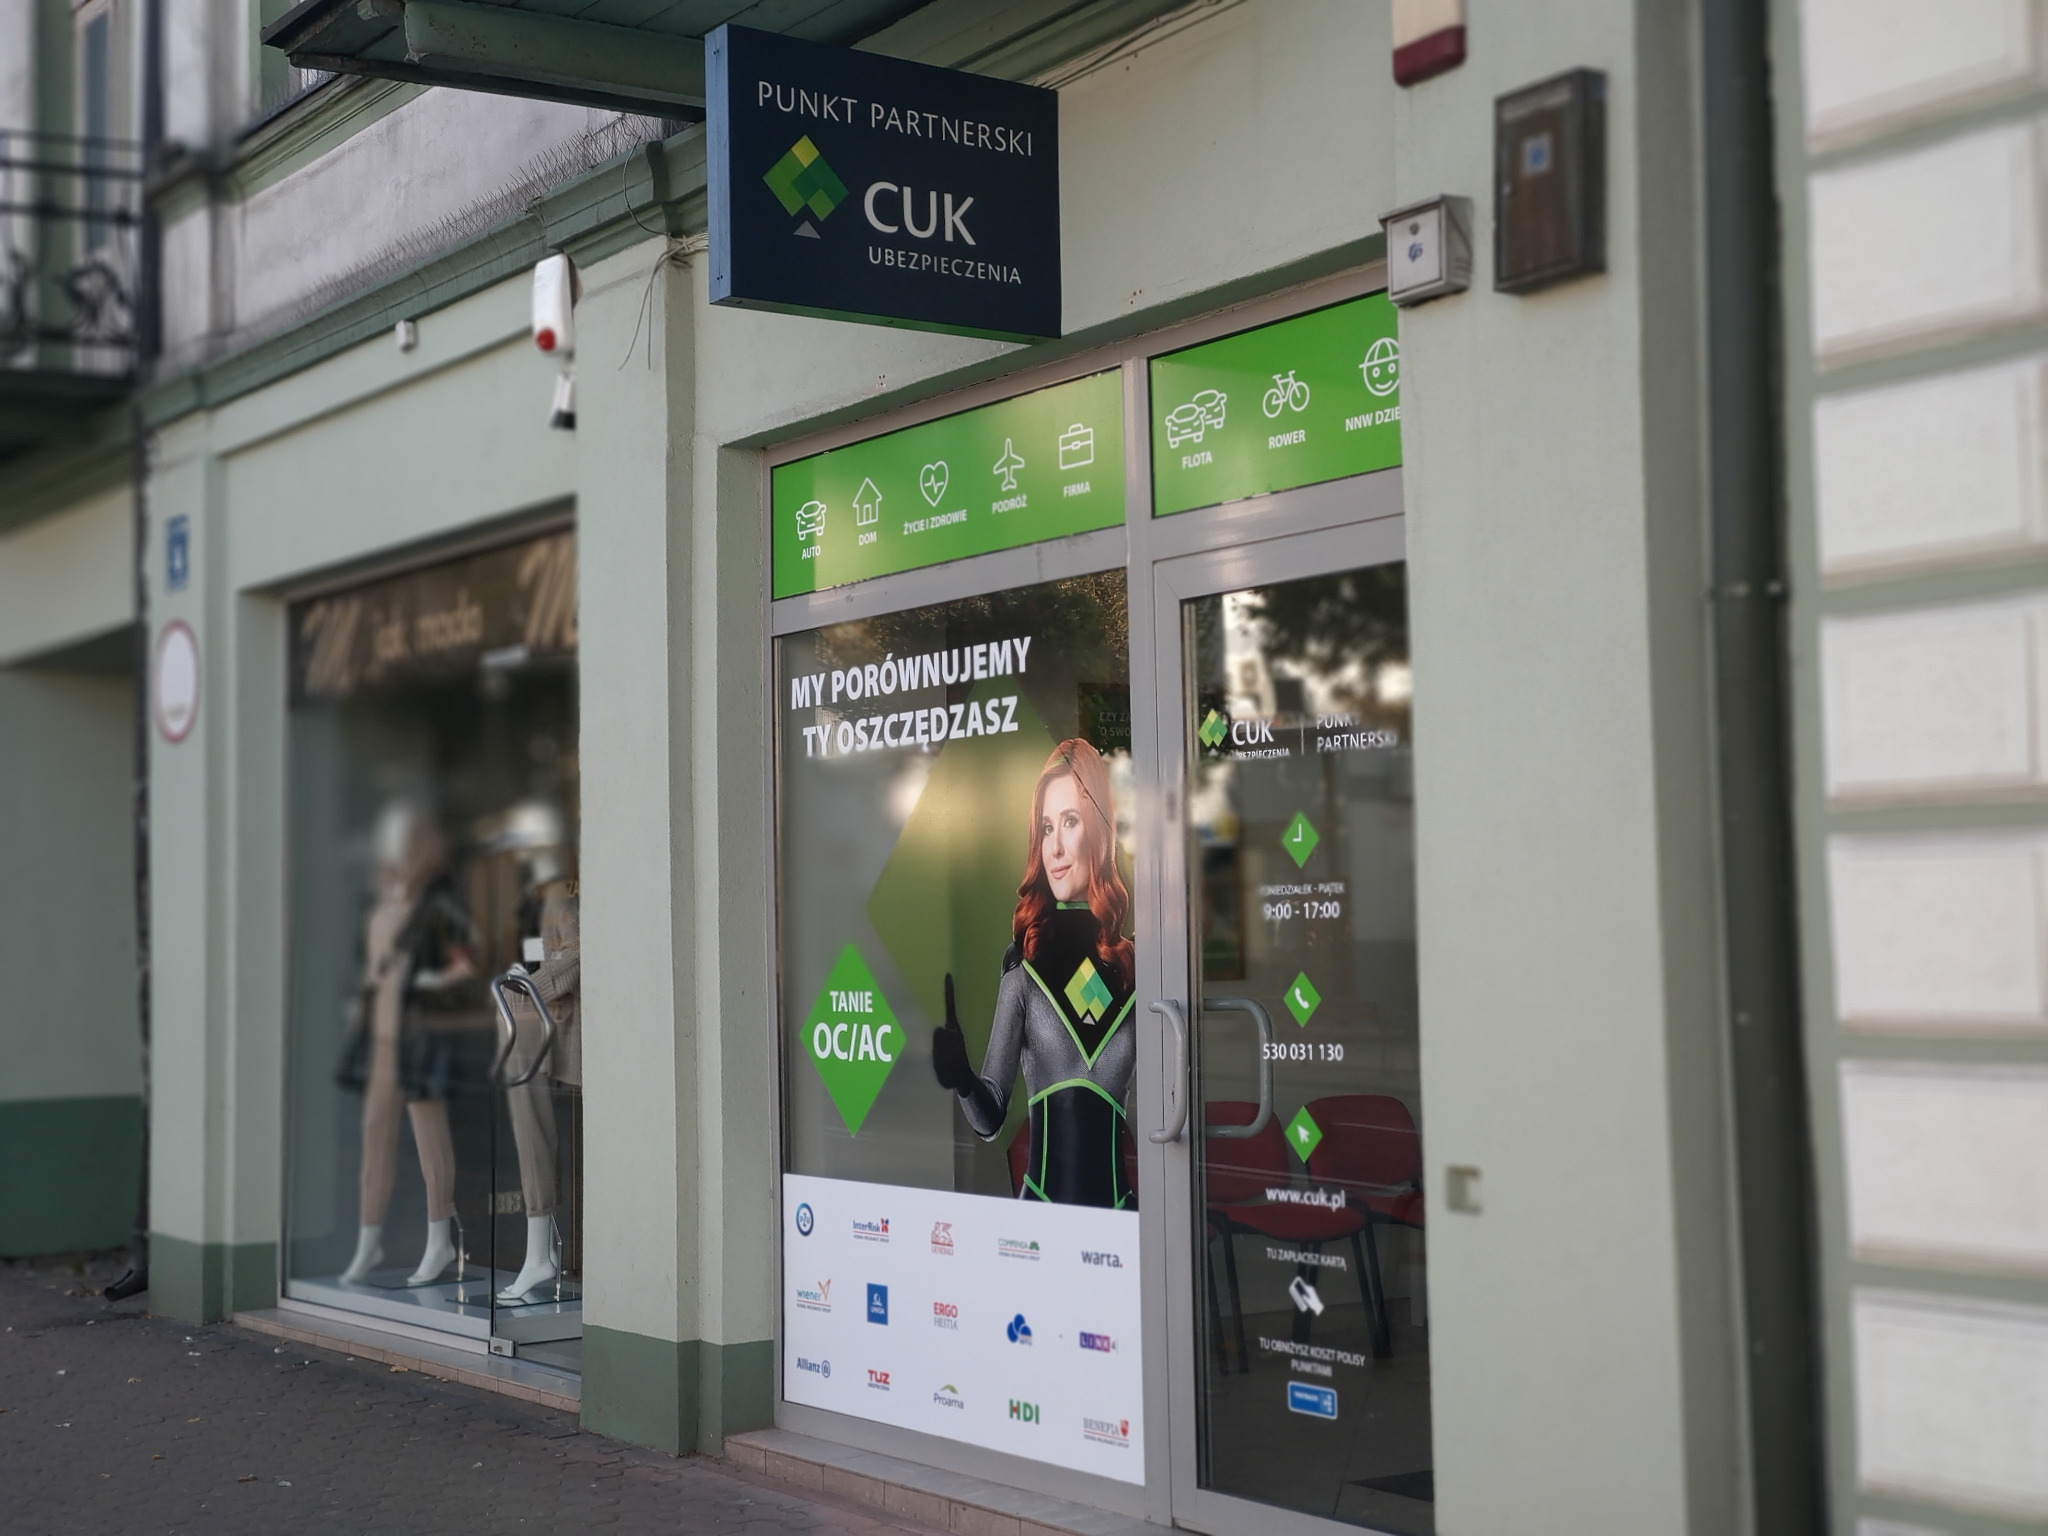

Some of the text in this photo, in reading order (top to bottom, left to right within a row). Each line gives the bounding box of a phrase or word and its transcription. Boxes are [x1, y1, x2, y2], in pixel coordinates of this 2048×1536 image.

[758, 81, 1033, 156] PUNKT PARTNERSKI
[864, 182, 976, 245] CUK
[868, 246, 1022, 285] UBEZPIECZENIA
[1345, 412, 1373, 431] NNW
[1268, 430, 1306, 449] ROWER
[1181, 451, 1213, 469] FLOTA
[1063, 481, 1091, 497] FIRMA
[992, 495, 1028, 514] PODRÓŻ
[903, 518, 925, 535] ŻYCIE
[930, 509, 967, 530] ZDROWIE
[858, 531, 877, 546] DOM
[801, 545, 821, 559] AUTO
[791, 636, 1031, 710] MY PORÓWNUJEMY
[803, 696, 1019, 758] TY OSZCZĘDZASZ
[1232, 719, 1274, 745] CUK
[1264, 903, 1292, 920] 9:00
[1303, 901, 1340, 919] 17:00
[830, 990, 873, 1013] TANIE
[813, 1022, 892, 1062] OC/AC
[1263, 1043, 1344, 1061] 530 031 130
[1266, 1188, 1346, 1212] www.cuk.pl
[853, 1220, 880, 1232] InterRisk
[1266, 1247, 1277, 1259] TU
[933, 1302, 958, 1318] ERGO
[1259, 1337, 1270, 1349] TU
[1310, 1347, 1335, 1361] KOSZT
[1337, 1350, 1365, 1366] POLISY
[796, 1357, 820, 1373] Allianz
[867, 1369, 890, 1385] TUZ
[933, 1392, 964, 1409] Proama
[1009, 1399, 1040, 1425] HDI
